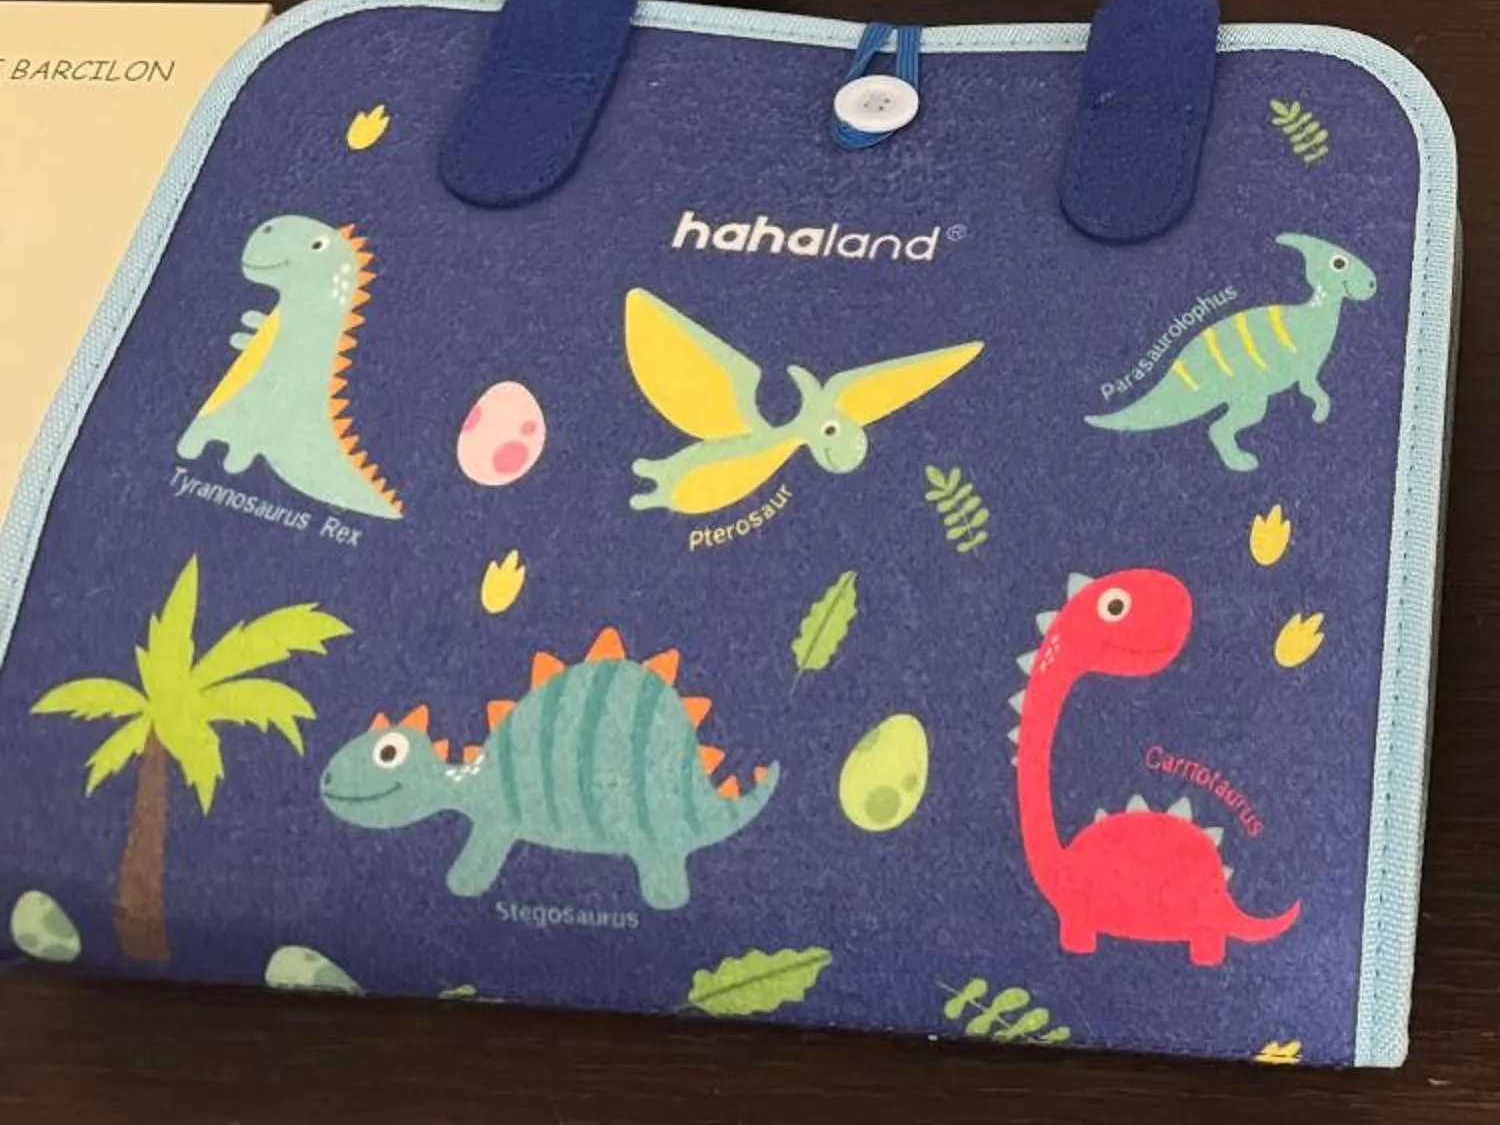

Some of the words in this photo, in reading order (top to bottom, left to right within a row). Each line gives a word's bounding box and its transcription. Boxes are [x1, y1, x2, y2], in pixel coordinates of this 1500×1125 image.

[10, 58, 175, 82] BARCILON
[671, 211, 940, 261] hahaland
[1101, 286, 1238, 401] Parasaurolophus
[169, 467, 311, 530] Tyrannosaurus
[319, 517, 362, 547] Rex
[1146, 746, 1264, 837] Carnotaurus
[495, 901, 640, 929] Stegosaurus
